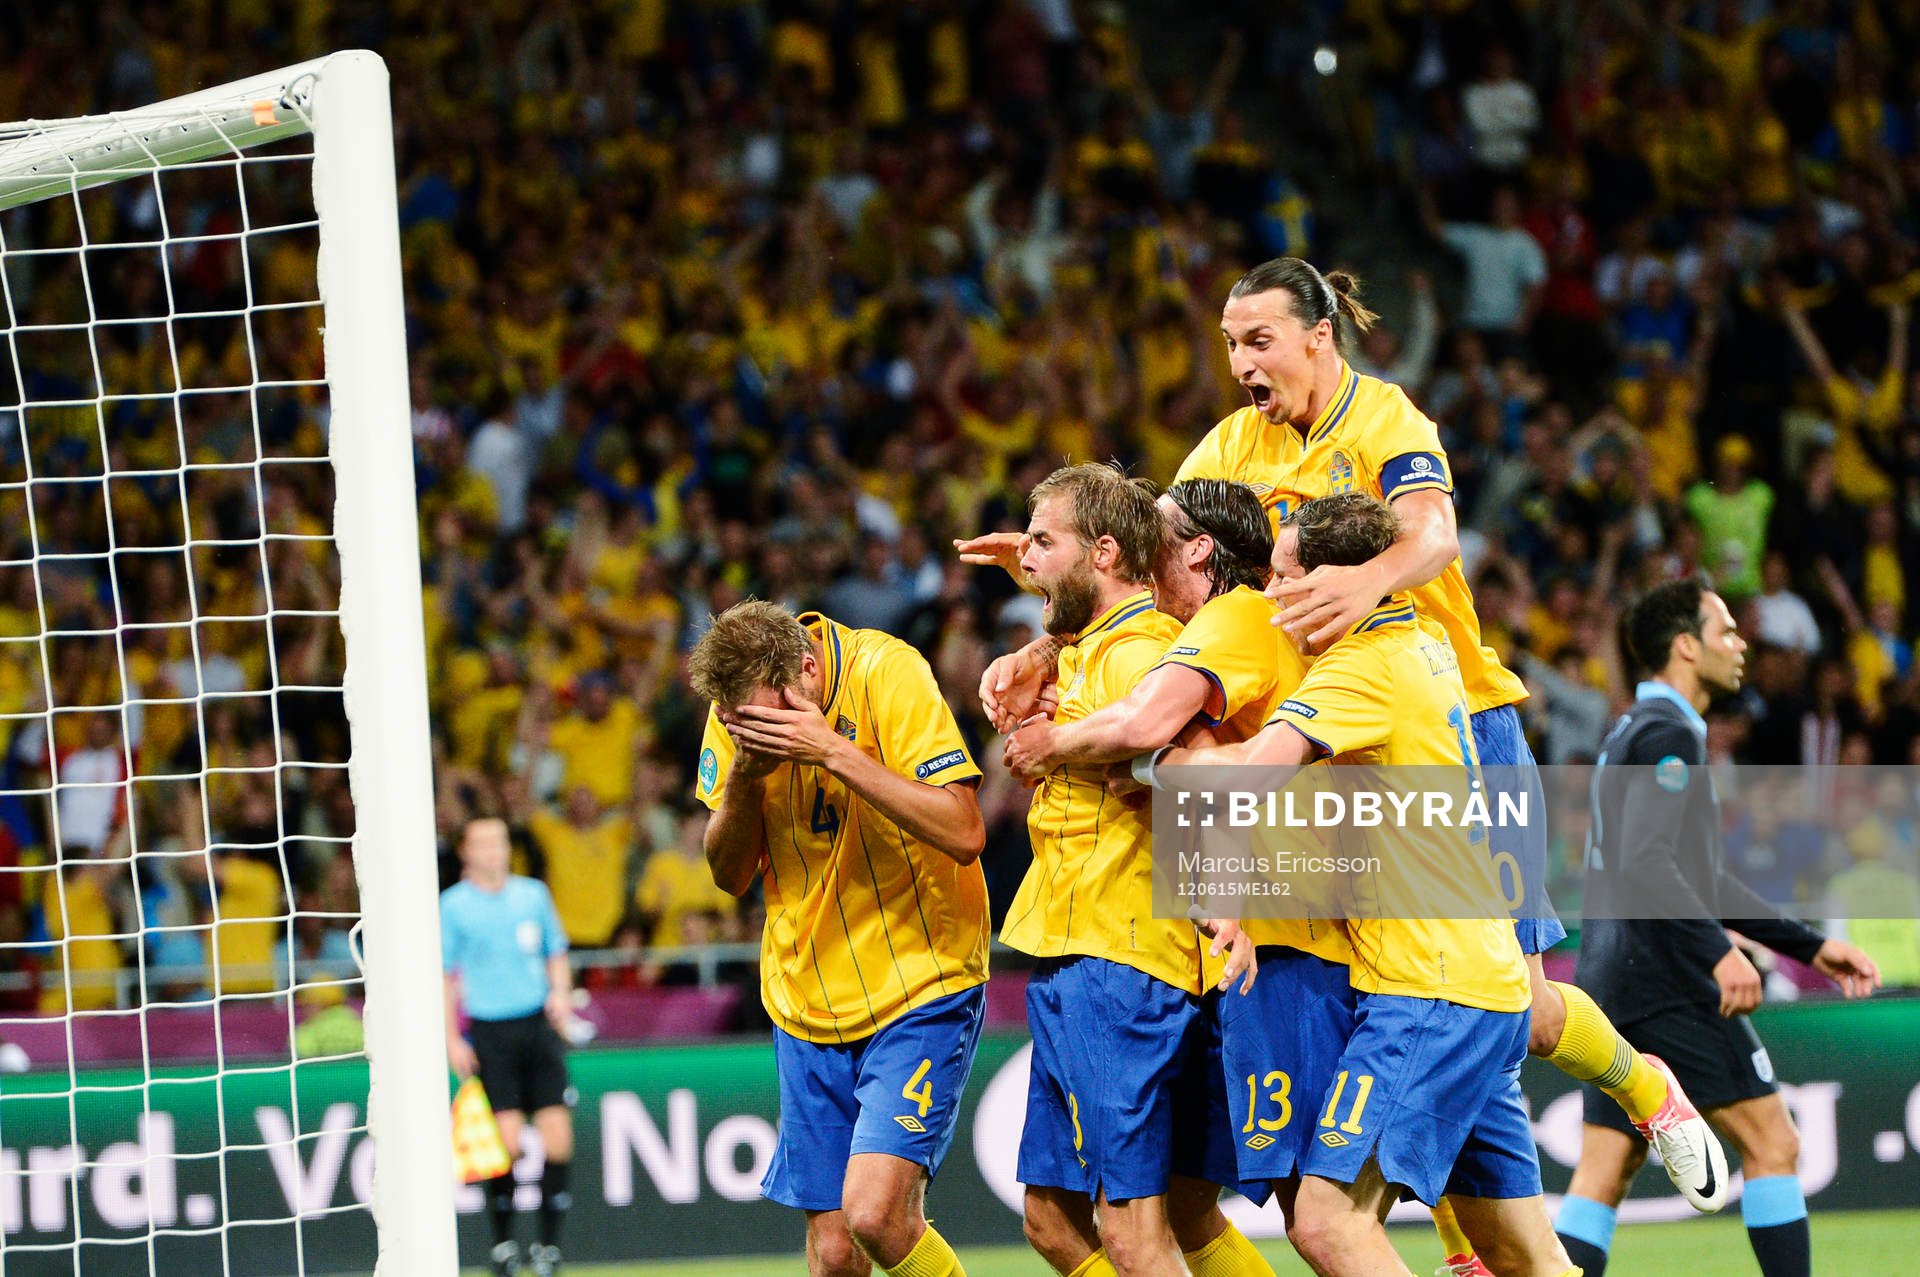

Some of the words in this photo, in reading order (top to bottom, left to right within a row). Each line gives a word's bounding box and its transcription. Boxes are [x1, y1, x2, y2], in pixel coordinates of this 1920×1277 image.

[1281, 700, 1317, 718] RESPECT
[927, 751, 964, 771] RESPECT
[810, 786, 841, 841] 4
[902, 1058, 933, 1118] 4
[1242, 1070, 1292, 1134] 13
[1319, 1070, 1374, 1135] 11
[601, 1088, 780, 1207] No
